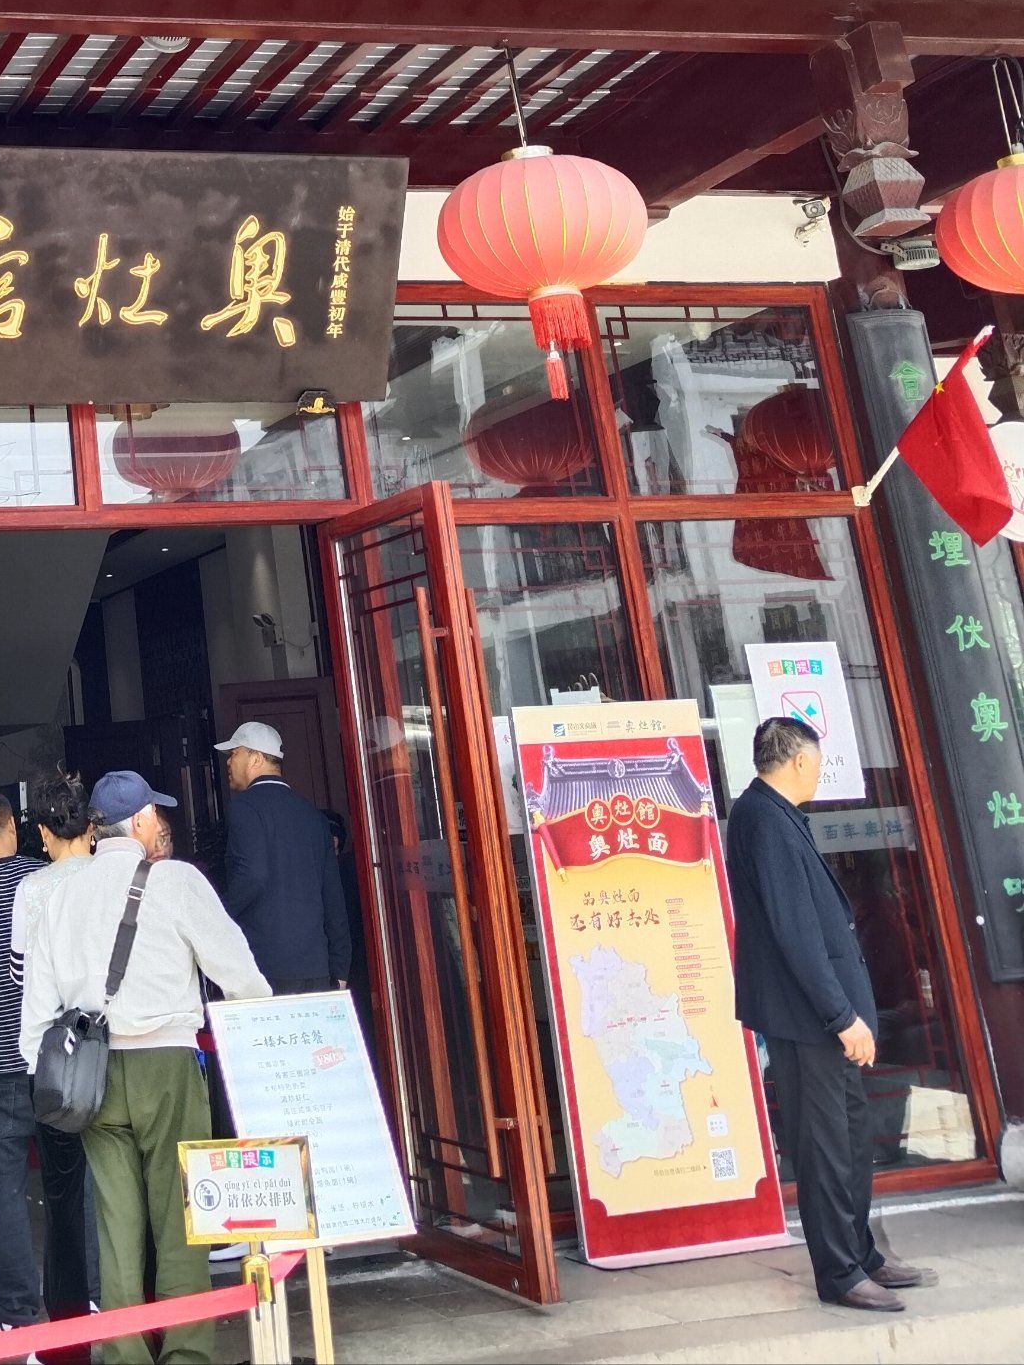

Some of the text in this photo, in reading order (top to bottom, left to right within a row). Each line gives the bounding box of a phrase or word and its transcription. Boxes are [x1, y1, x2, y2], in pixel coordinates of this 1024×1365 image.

[588, 827, 669, 861] 奥灶面
[252, 1030, 325, 1049] 二楼大厅套餐
[227, 1191, 297, 1208] 请依次排队
